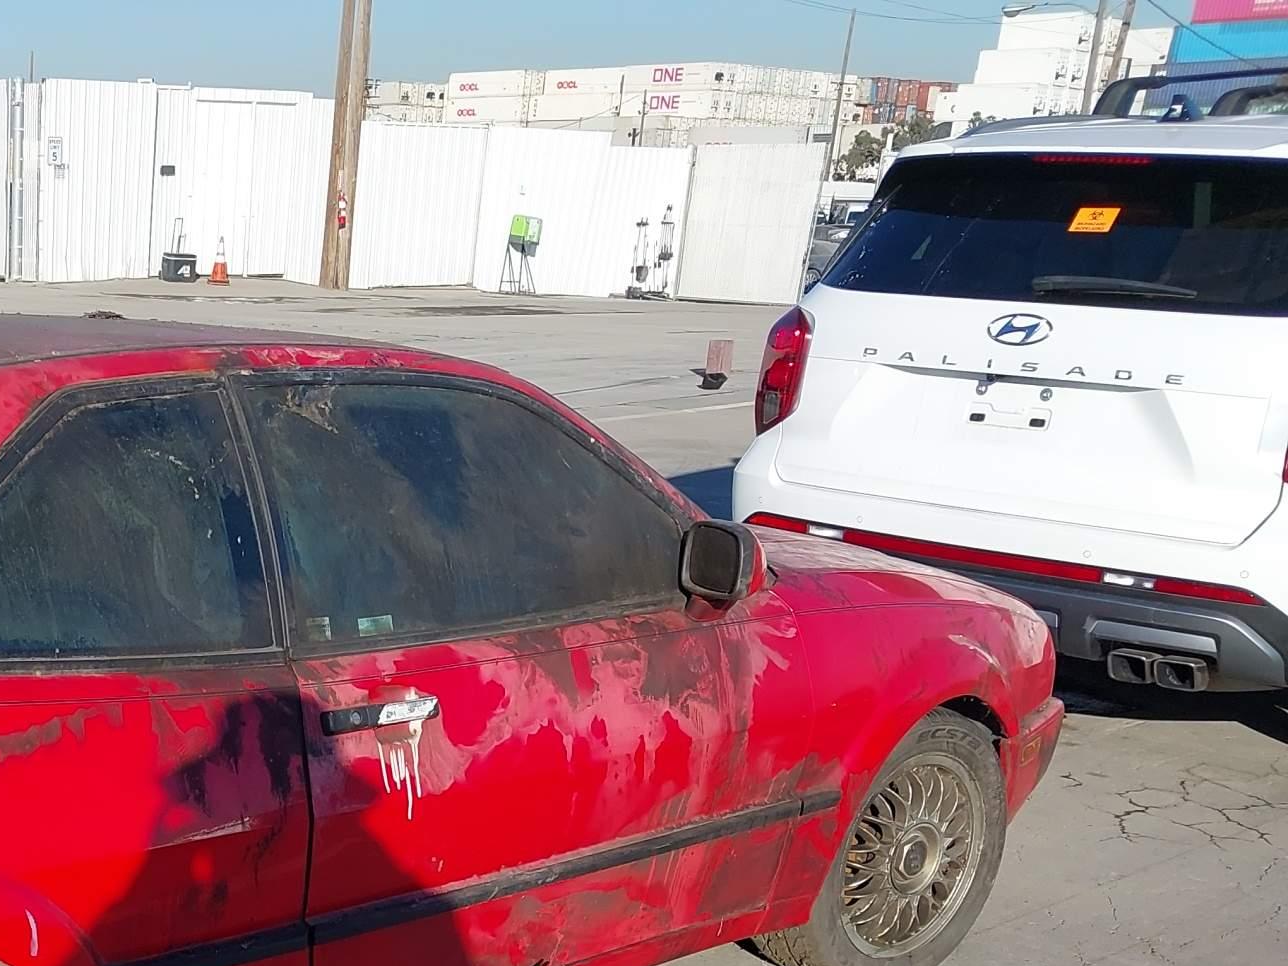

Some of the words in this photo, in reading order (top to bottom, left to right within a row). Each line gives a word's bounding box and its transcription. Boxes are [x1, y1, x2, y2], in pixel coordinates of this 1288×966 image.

[653, 67, 684, 82] ONE
[557, 81, 578, 89] OOCL
[649, 95, 680, 110] ONE
[52, 151, 58, 161] 5
[863, 347, 1185, 385] PALISADE
